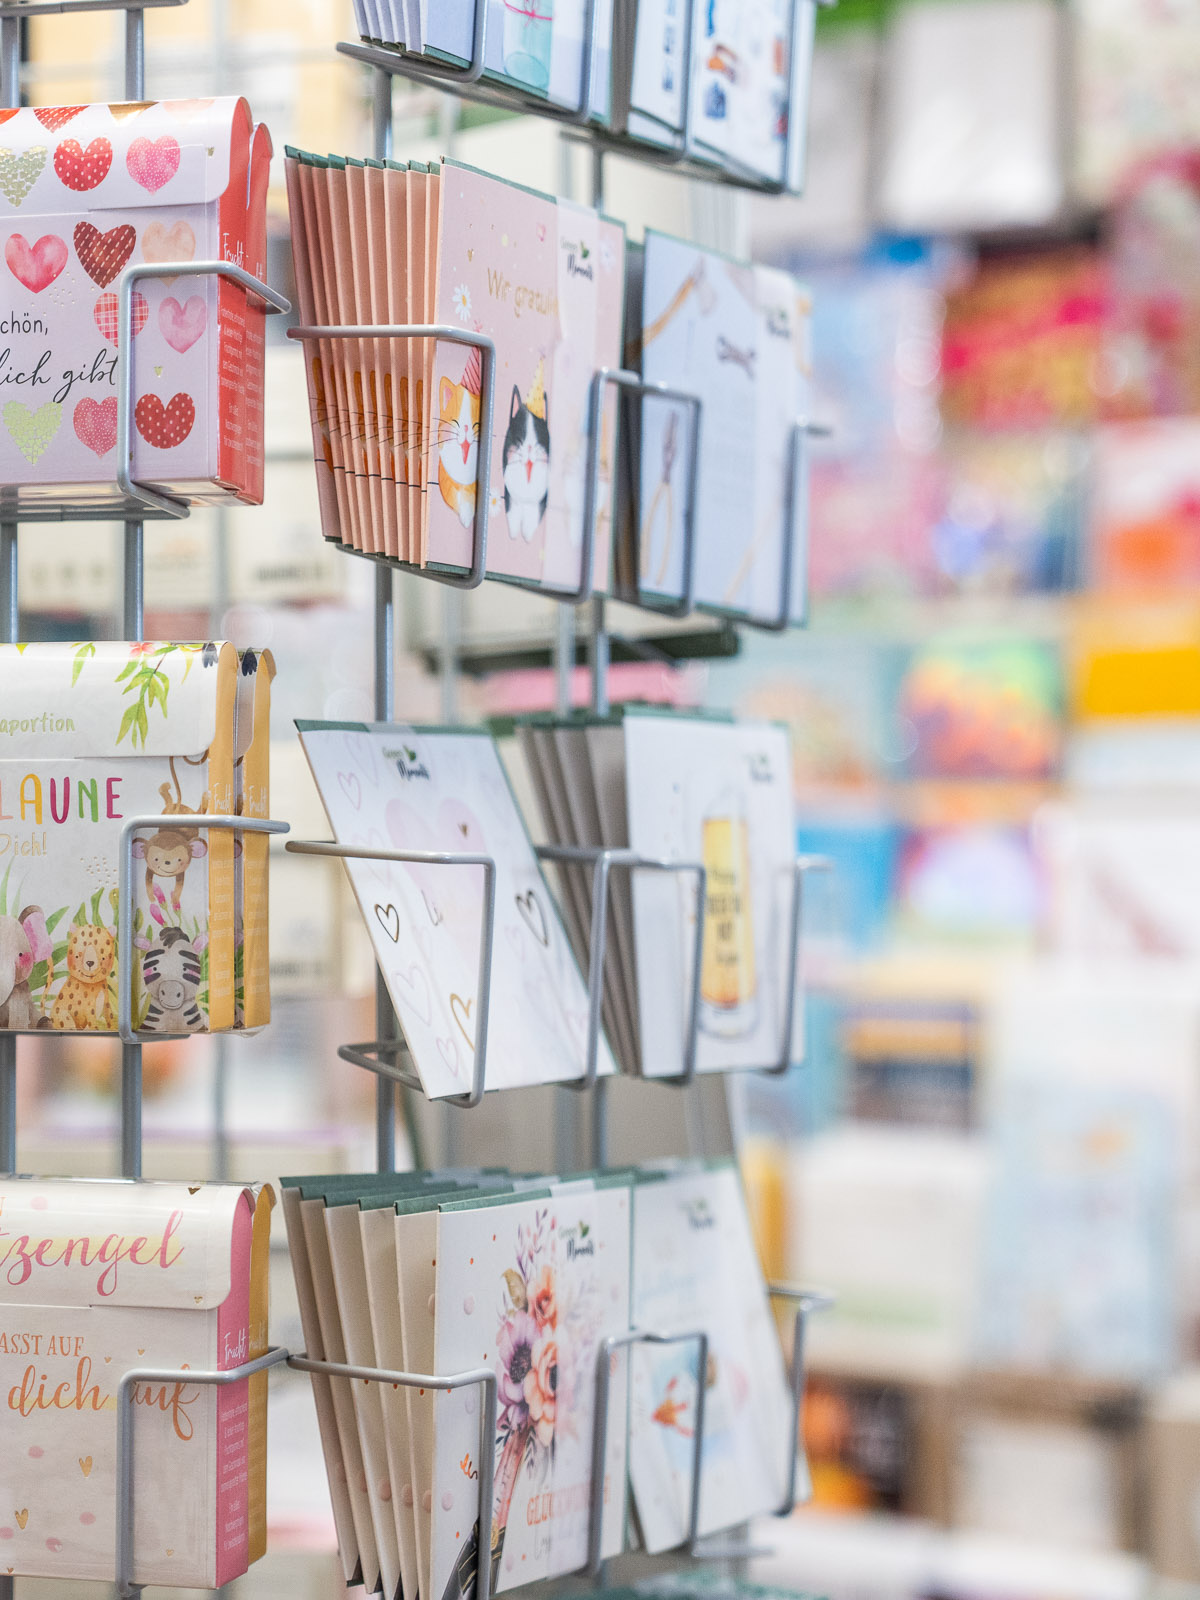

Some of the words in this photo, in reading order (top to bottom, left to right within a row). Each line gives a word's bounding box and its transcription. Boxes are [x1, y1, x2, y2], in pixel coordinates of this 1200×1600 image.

[52, 348, 119, 404] gibt
[46, 1335, 85, 1357] AUF
[7, 1355, 110, 1418] dich
[129, 1363, 201, 1441] uf
